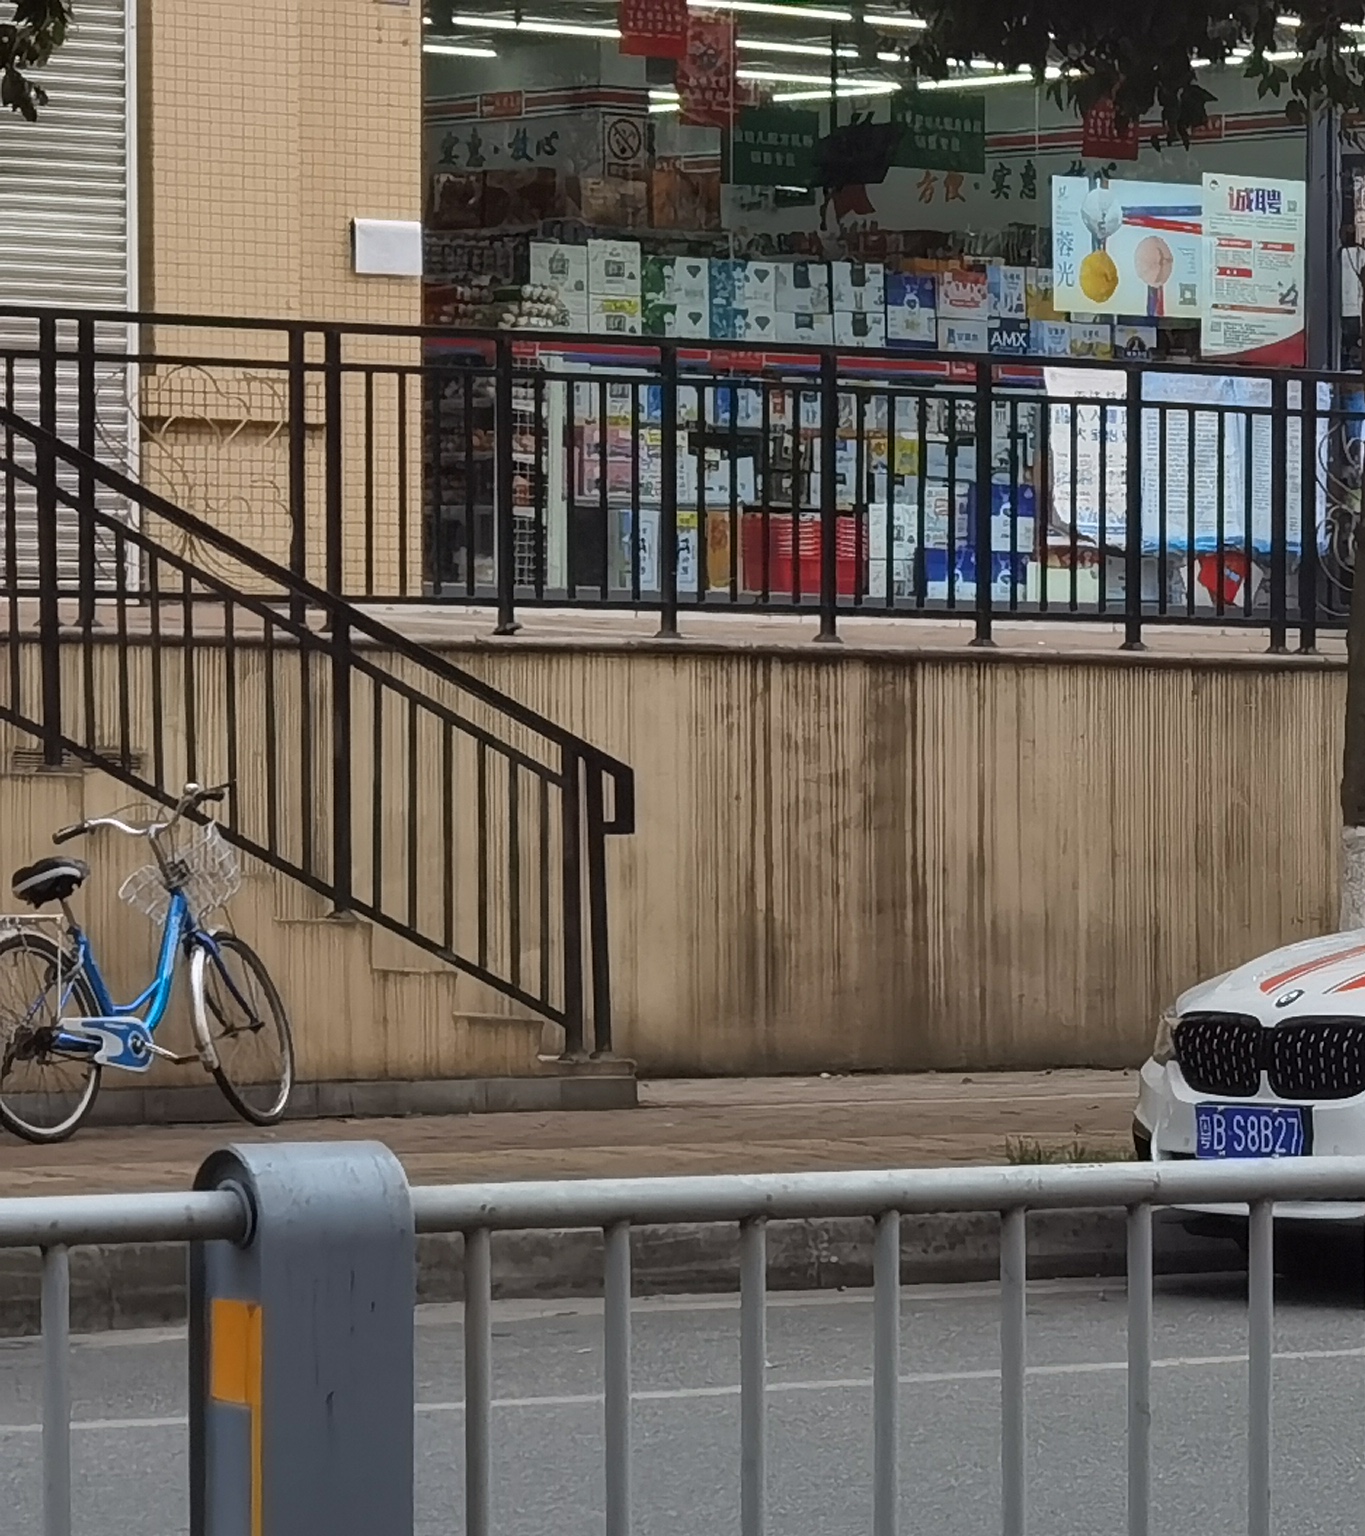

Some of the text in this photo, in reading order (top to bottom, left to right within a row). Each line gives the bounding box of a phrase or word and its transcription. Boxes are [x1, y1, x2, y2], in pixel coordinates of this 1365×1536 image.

[1228, 186, 1283, 215] 诚聘
[1055, 230, 1075, 288] 蓉光
[990, 331, 1028, 348] AMX
